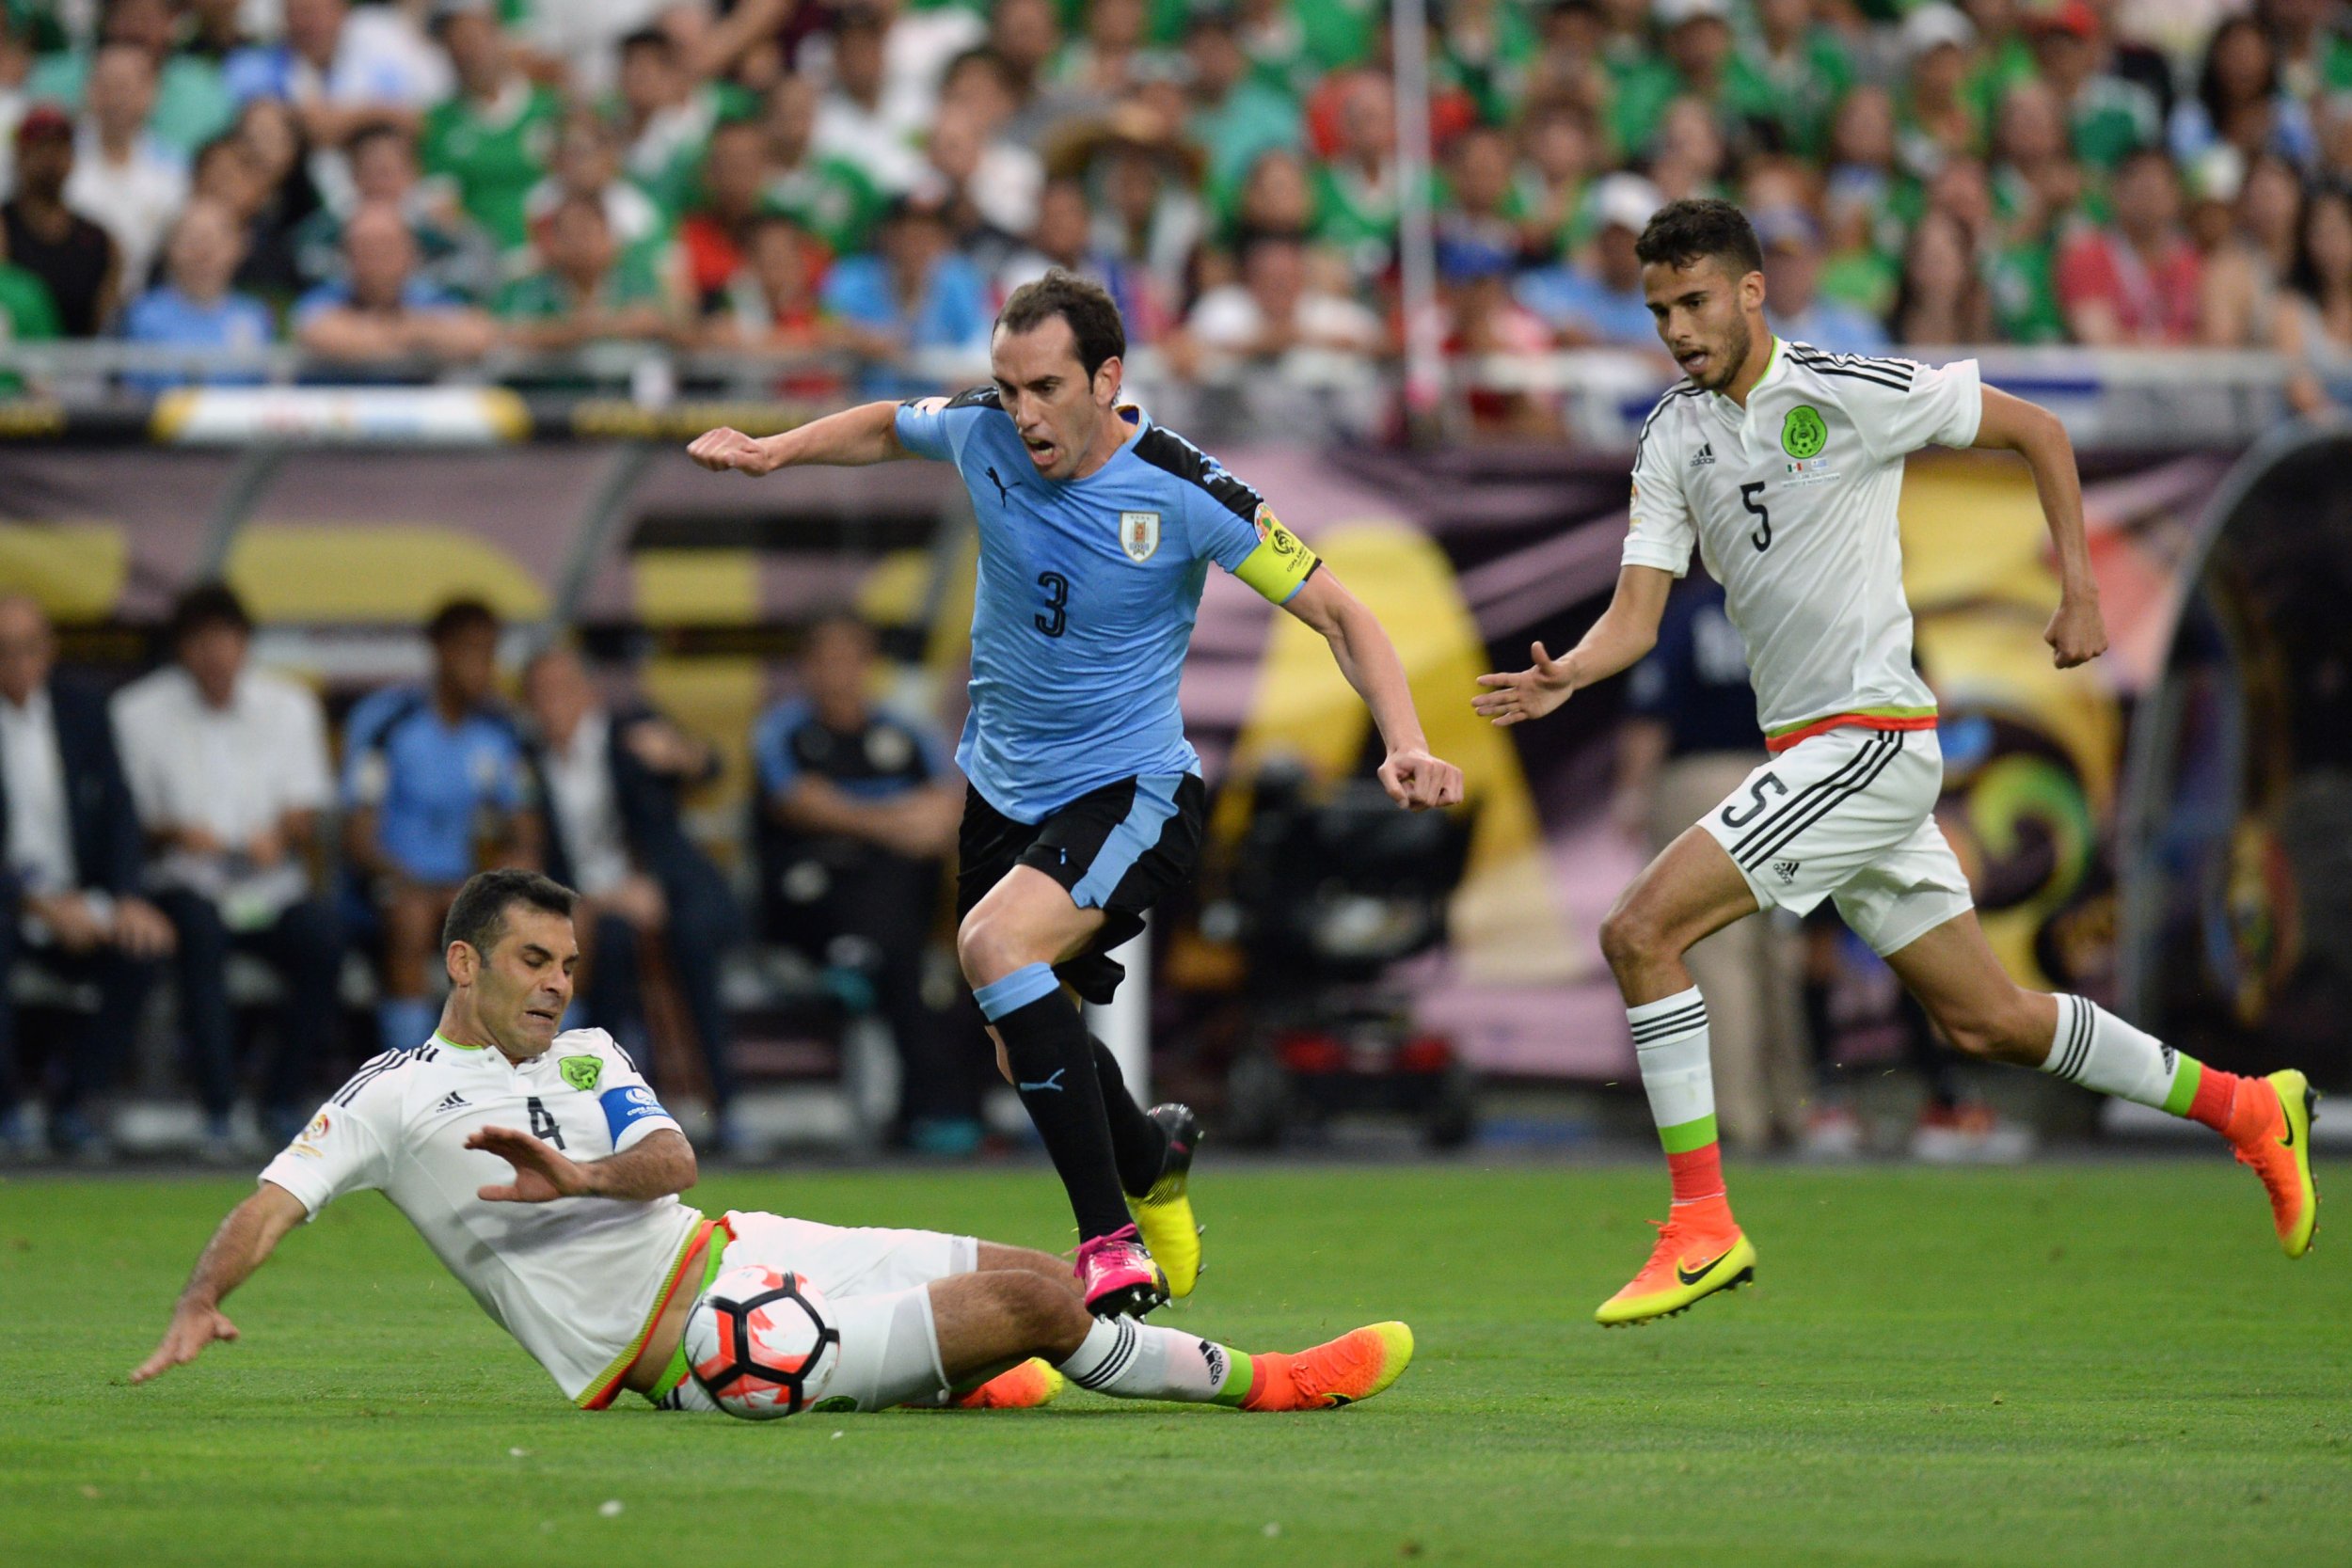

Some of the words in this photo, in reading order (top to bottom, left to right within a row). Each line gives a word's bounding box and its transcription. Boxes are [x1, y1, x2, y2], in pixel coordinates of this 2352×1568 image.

[1690, 456, 1716, 467] adidas
[1740, 481, 1772, 552] 5
[1034, 571, 1069, 638] 3
[1721, 771, 1788, 828] 5
[527, 1097, 566, 1150] 4
